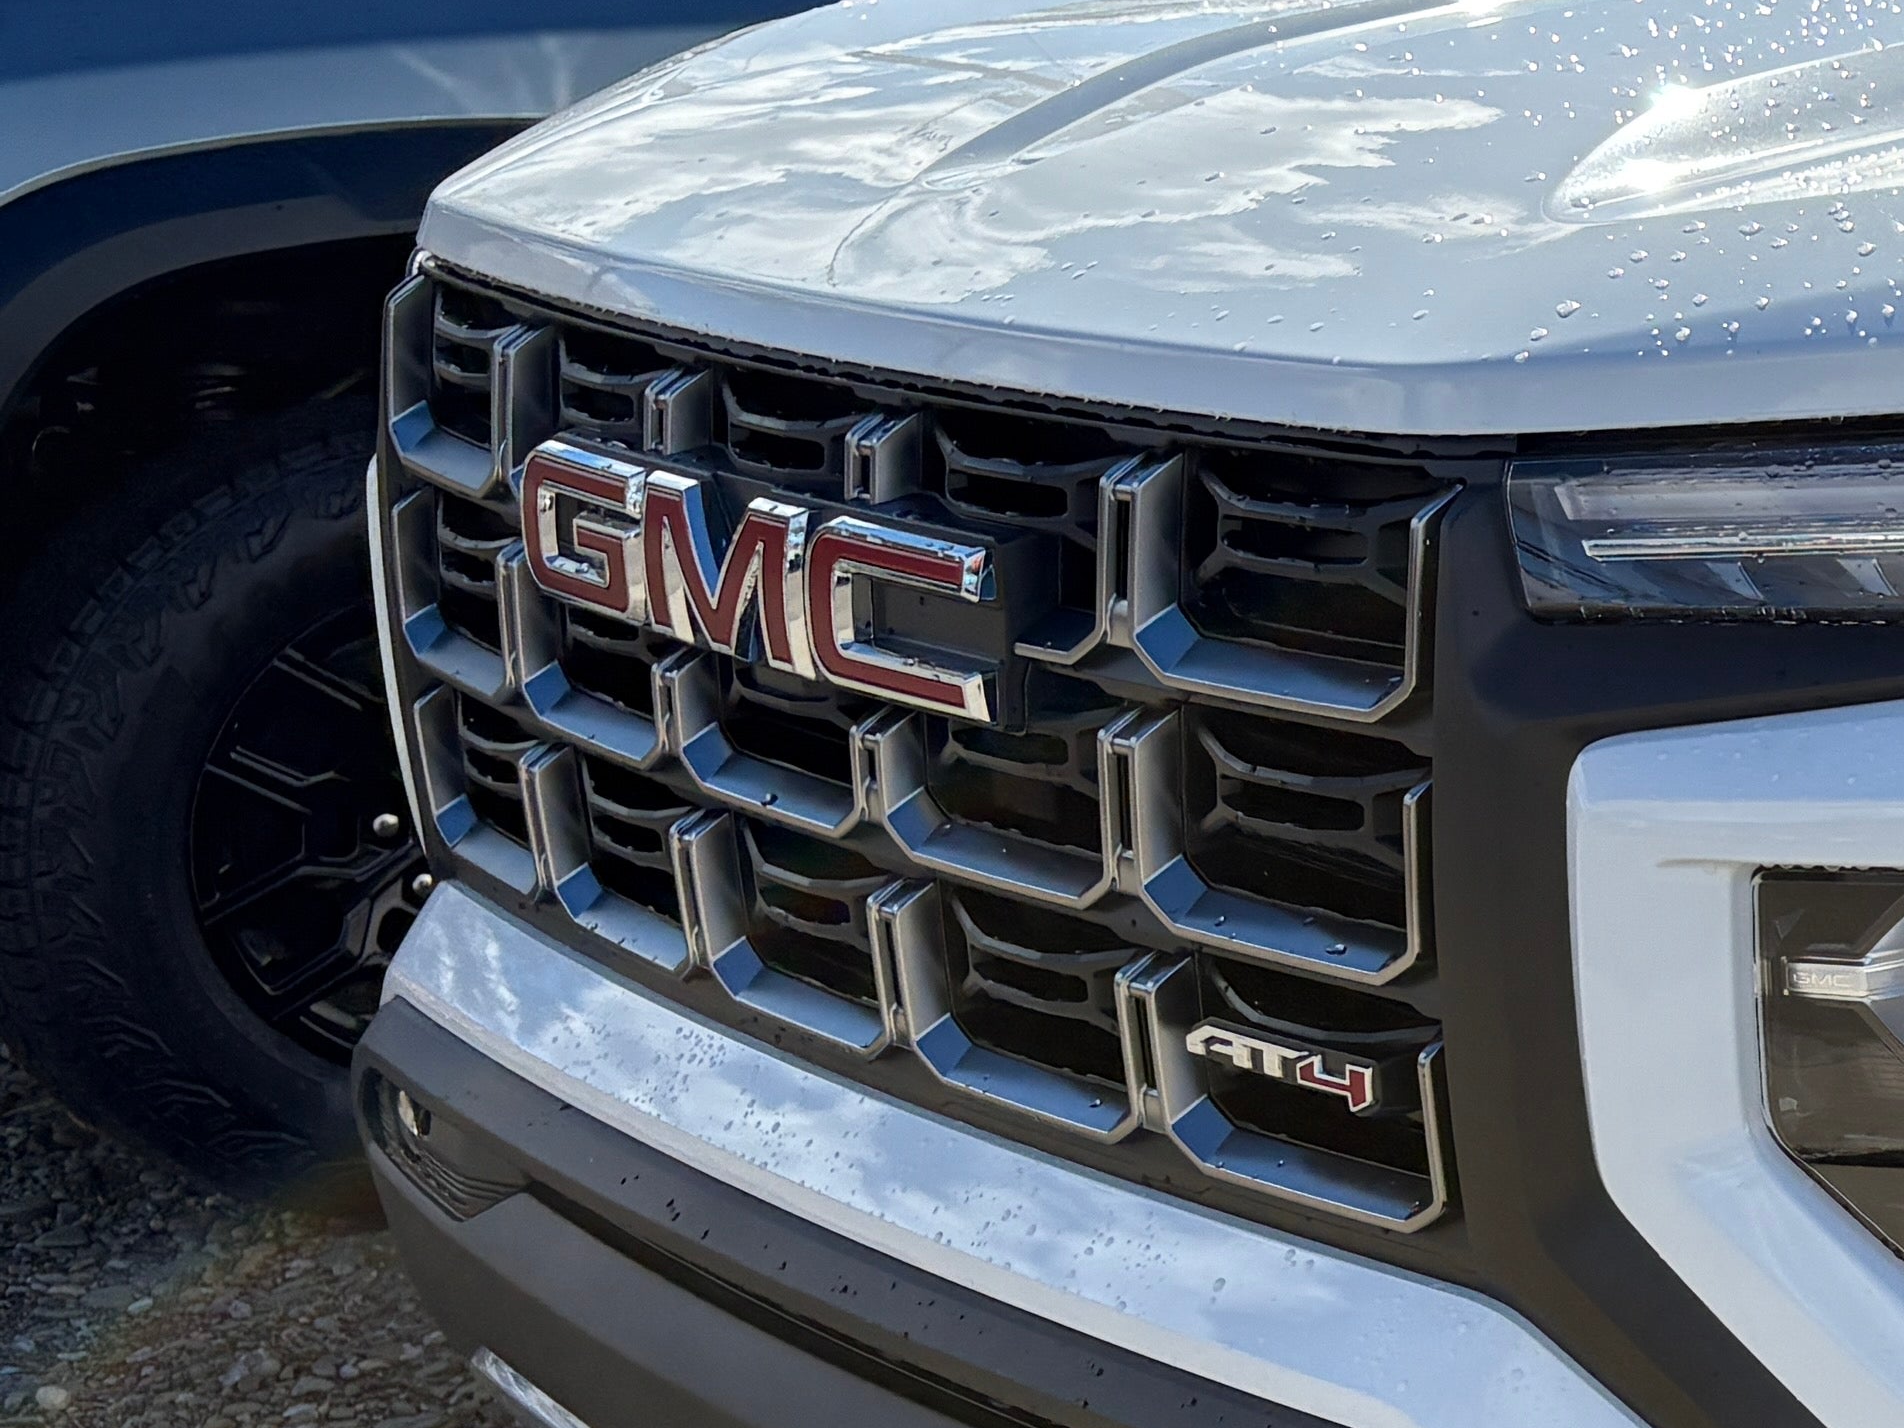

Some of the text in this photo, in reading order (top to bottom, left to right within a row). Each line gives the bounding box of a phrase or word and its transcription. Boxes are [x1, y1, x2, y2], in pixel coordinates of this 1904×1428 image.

[521, 440, 997, 724] GMC
[1793, 971, 1851, 988] GMC
[1186, 1024, 1373, 1112] AT4
